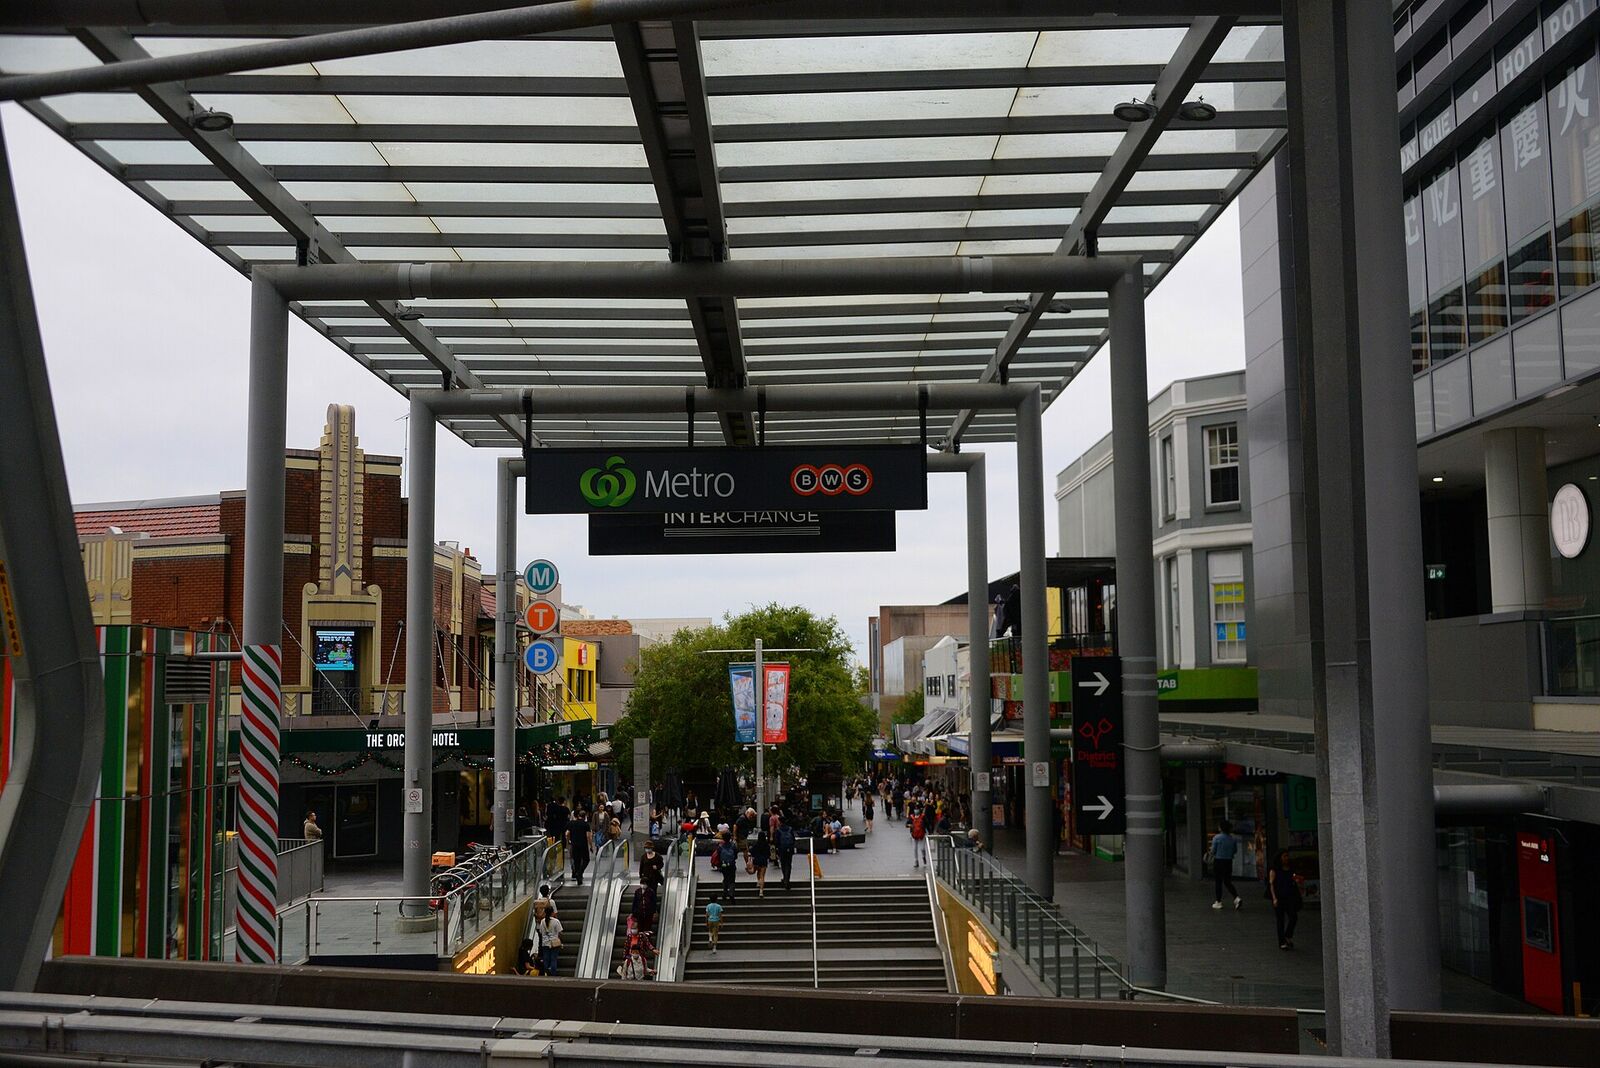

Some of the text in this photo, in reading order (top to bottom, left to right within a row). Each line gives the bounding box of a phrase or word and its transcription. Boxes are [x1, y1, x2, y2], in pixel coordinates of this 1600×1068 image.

[1501, 36, 1536, 85] HOT
[644, 467, 735, 499] Metro
[801, 473, 862, 486] BWS
[532, 567, 550, 587] M
[534, 608, 548, 627] T
[534, 648, 548, 668] B
[1156, 679, 1177, 689] TAB
[366, 733, 384, 748] THE
[432, 732, 460, 747] HOTEL
